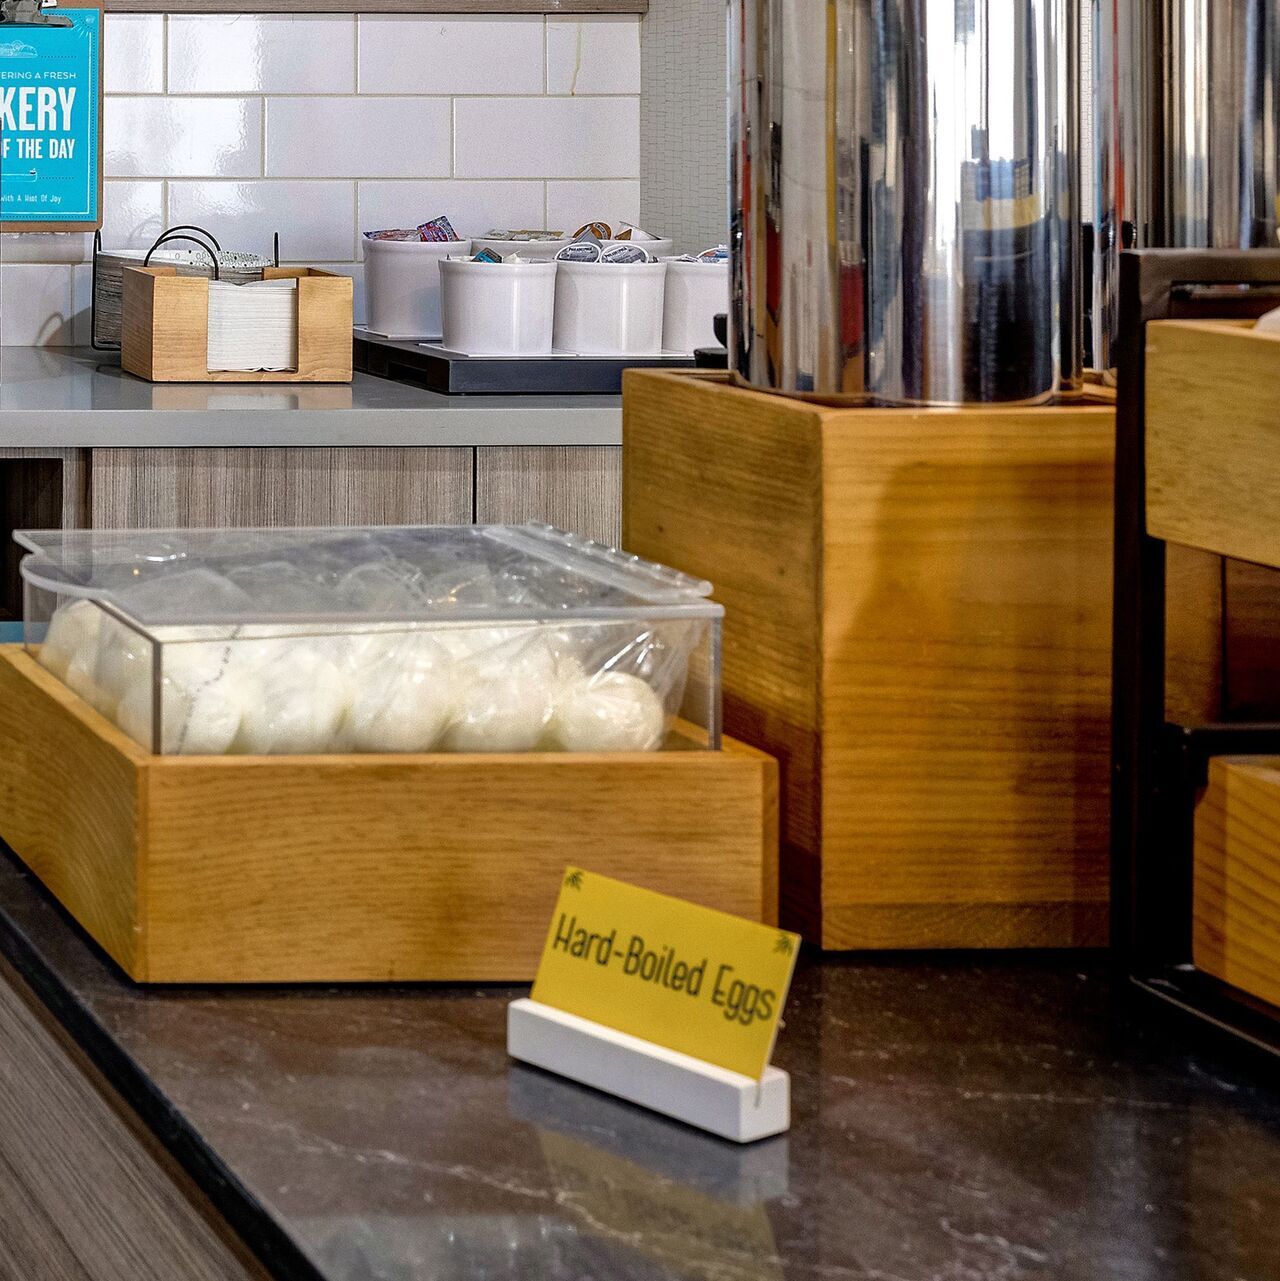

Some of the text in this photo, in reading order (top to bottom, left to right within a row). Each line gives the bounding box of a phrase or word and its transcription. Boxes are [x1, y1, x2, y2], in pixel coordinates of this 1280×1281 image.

[34, 71, 41, 79] A
[44, 71, 76, 79] FRESH
[16, 138, 44, 159] THE
[49, 138, 76, 159] DAY
[552, 912, 777, 1027] Hard-Boiled Eggs
